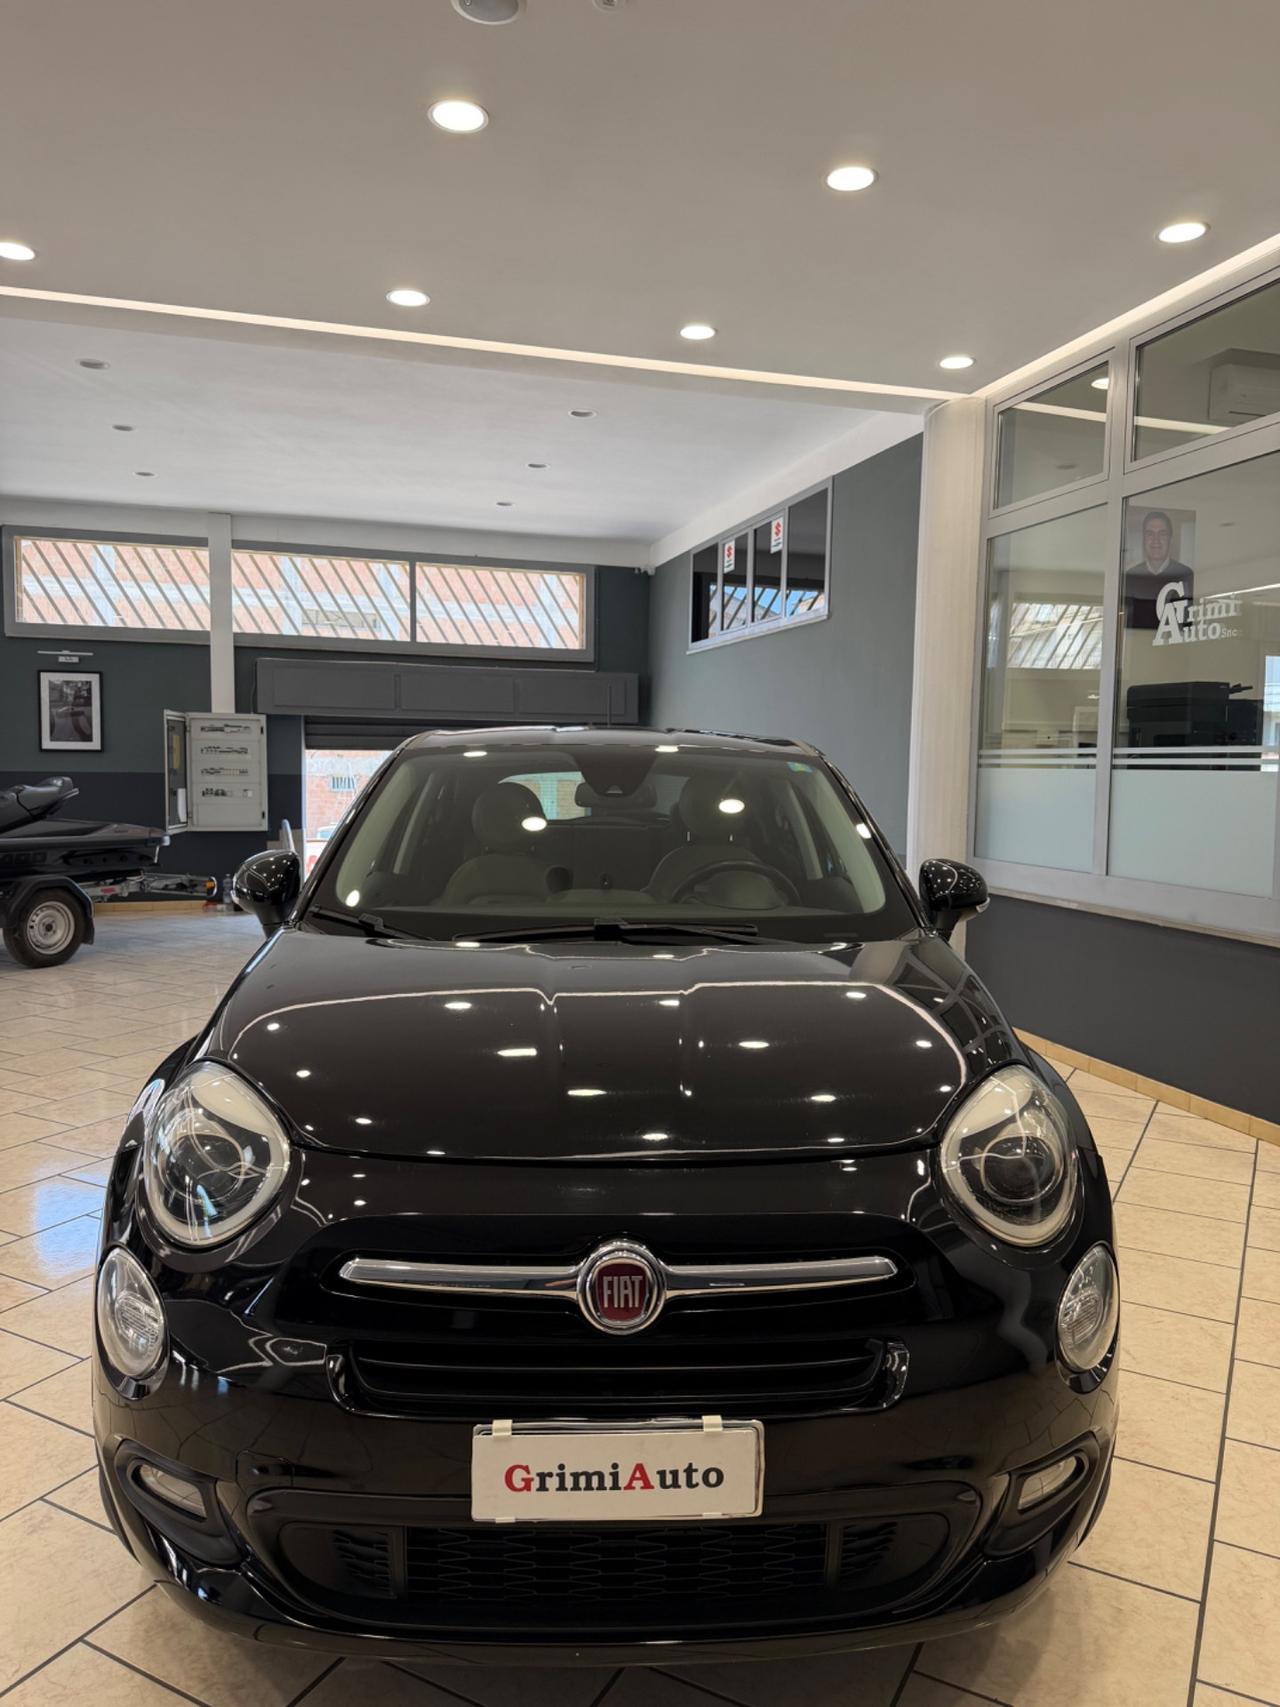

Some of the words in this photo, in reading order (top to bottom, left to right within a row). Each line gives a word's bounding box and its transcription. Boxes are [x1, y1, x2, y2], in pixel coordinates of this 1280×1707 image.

[1156, 581, 1239, 623] Grimi
[1152, 603, 1221, 646] Auto
[603, 1276, 643, 1308] FIAT
[504, 1462, 724, 1492] GrimiAuto
